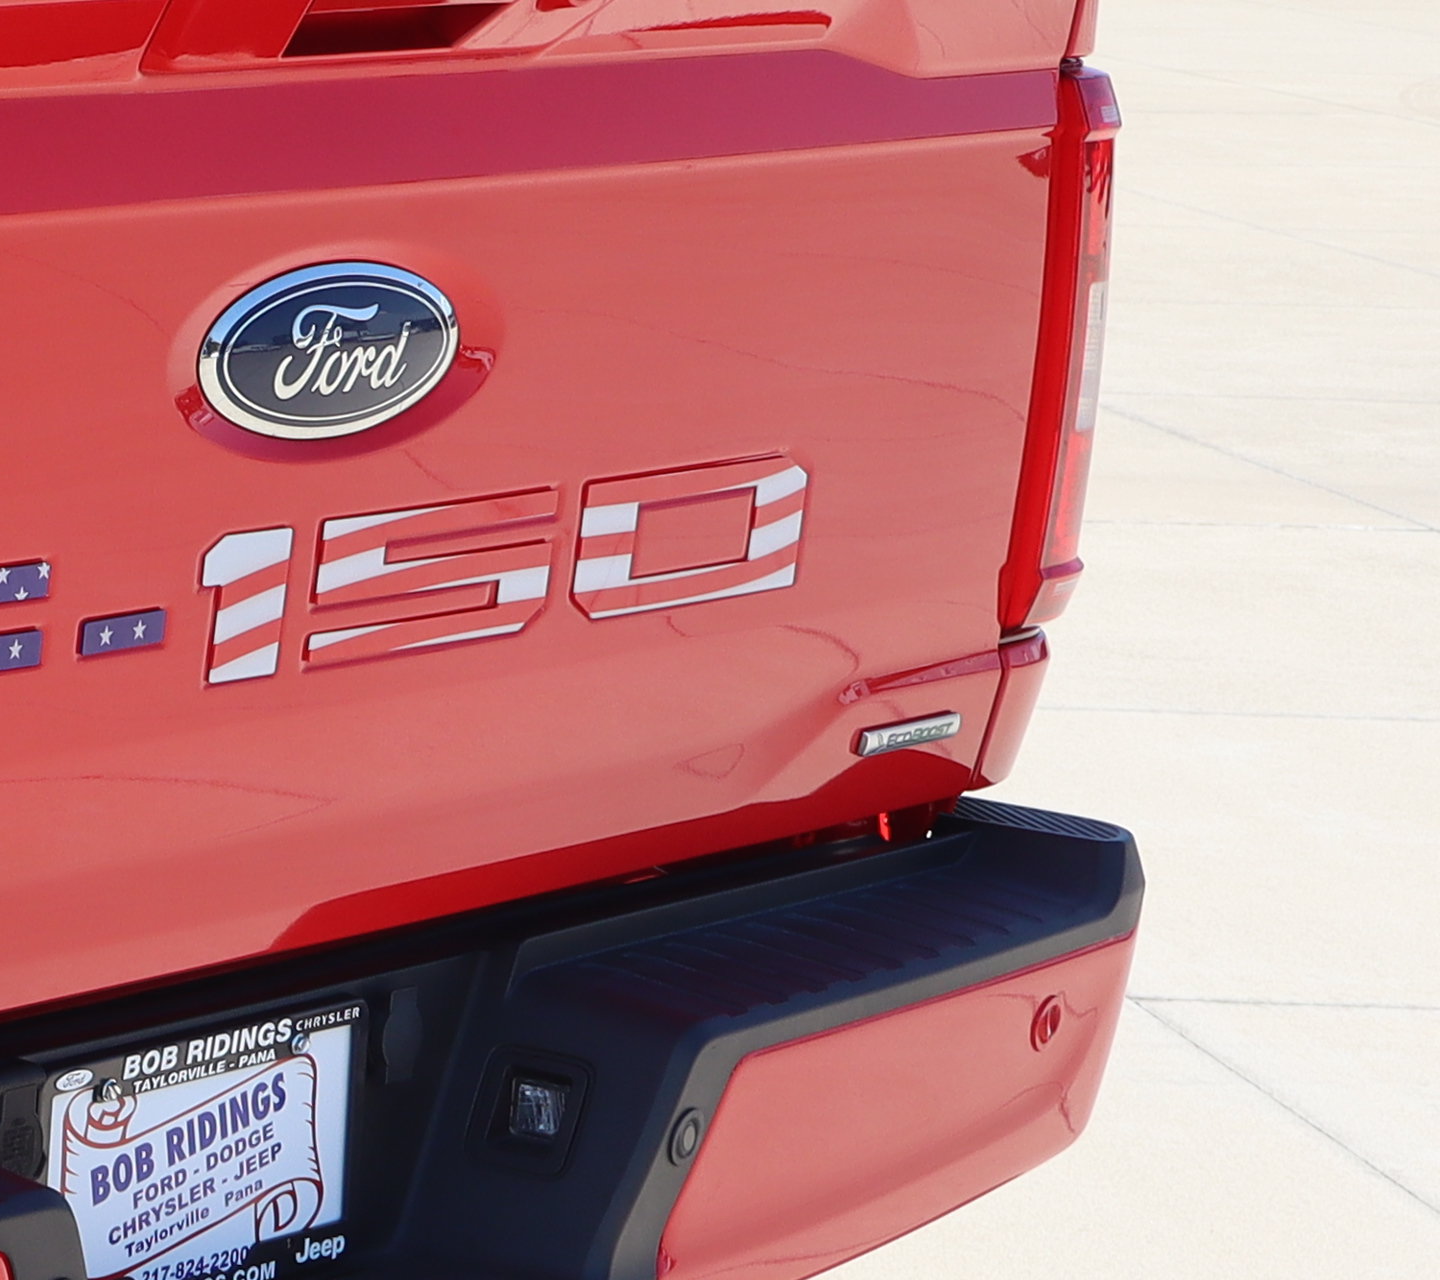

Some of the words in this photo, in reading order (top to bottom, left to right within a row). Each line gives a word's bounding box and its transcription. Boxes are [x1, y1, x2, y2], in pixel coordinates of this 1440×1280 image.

[273, 303, 411, 400] Ford
[122, 1045, 179, 1081] BOB
[186, 1018, 293, 1065] RIDINGS
[295, 1006, 361, 1032] CHRYSLER
[133, 1062, 227, 1094] TAYLORVILLE
[238, 1048, 277, 1069] PANA
[90, 1141, 155, 1207] BOB
[165, 1072, 287, 1168] RIDINGS
[132, 1168, 187, 1210] FORD
[206, 1121, 275, 1171] DODGE
[108, 1177, 216, 1246] CHRYSLER
[233, 1141, 282, 1181] JEEP
[124, 1206, 210, 1258] Taylorville
[224, 1179, 264, 1208] Pana
[295, 1234, 346, 1264] Jeep
